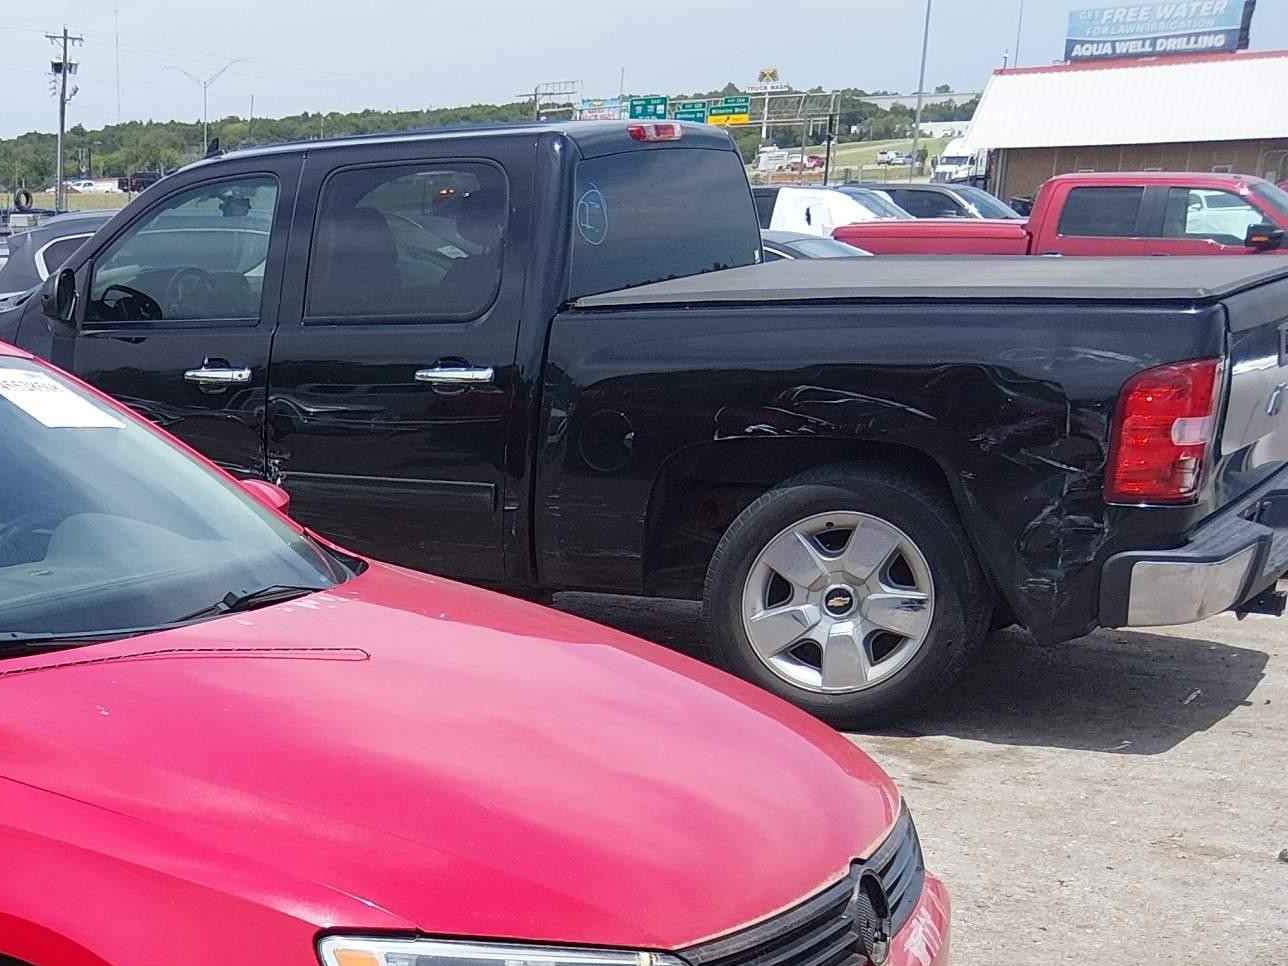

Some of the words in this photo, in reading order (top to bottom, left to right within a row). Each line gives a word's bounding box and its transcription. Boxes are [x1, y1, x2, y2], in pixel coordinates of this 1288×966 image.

[1101, 6, 1153, 24] FREE
[1155, 0, 1228, 19] WATER
[1086, 25, 1111, 36] FOR
[1071, 42, 1113, 57] AQUA
[1114, 38, 1153, 53] WELL
[1156, 34, 1226, 51] DRILLING
